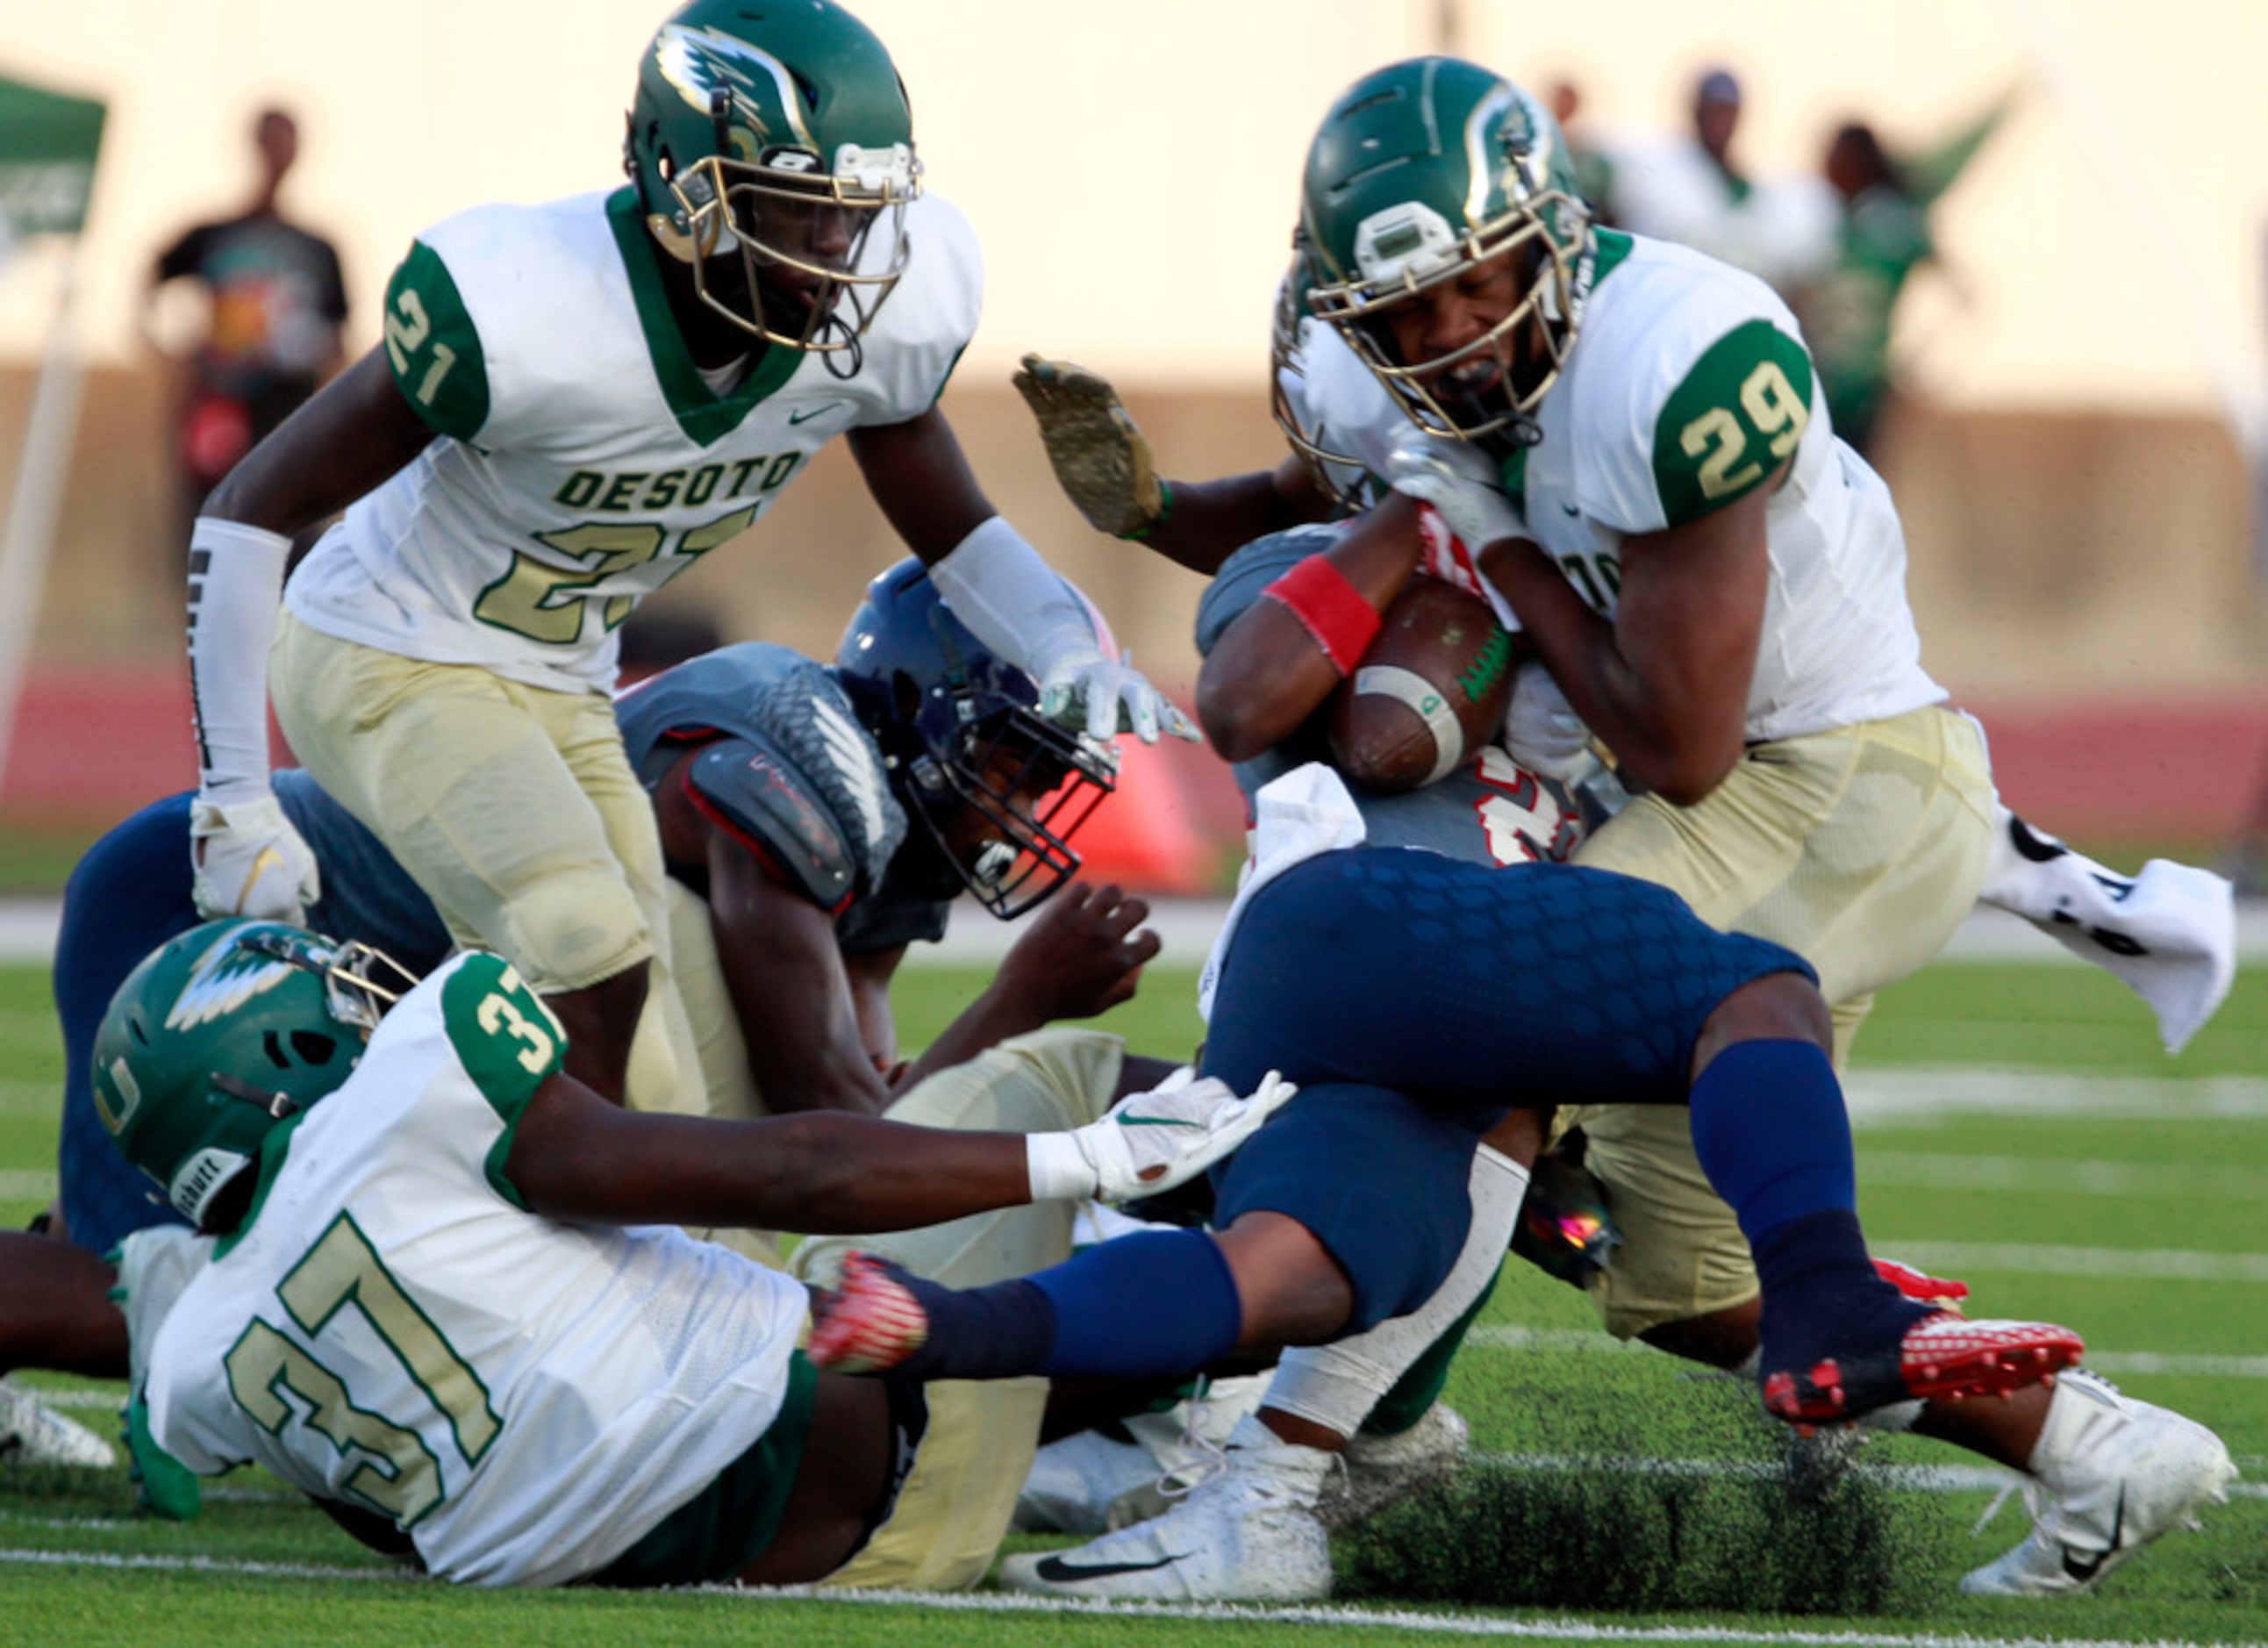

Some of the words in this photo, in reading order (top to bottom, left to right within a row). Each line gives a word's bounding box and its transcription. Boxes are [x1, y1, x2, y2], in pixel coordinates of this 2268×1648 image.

[384, 287, 457, 406] 21
[553, 449, 802, 512] DESOTO
[1679, 361, 1809, 499] 29
[476, 965, 568, 1075] 37
[223, 1208, 504, 1530] 37
